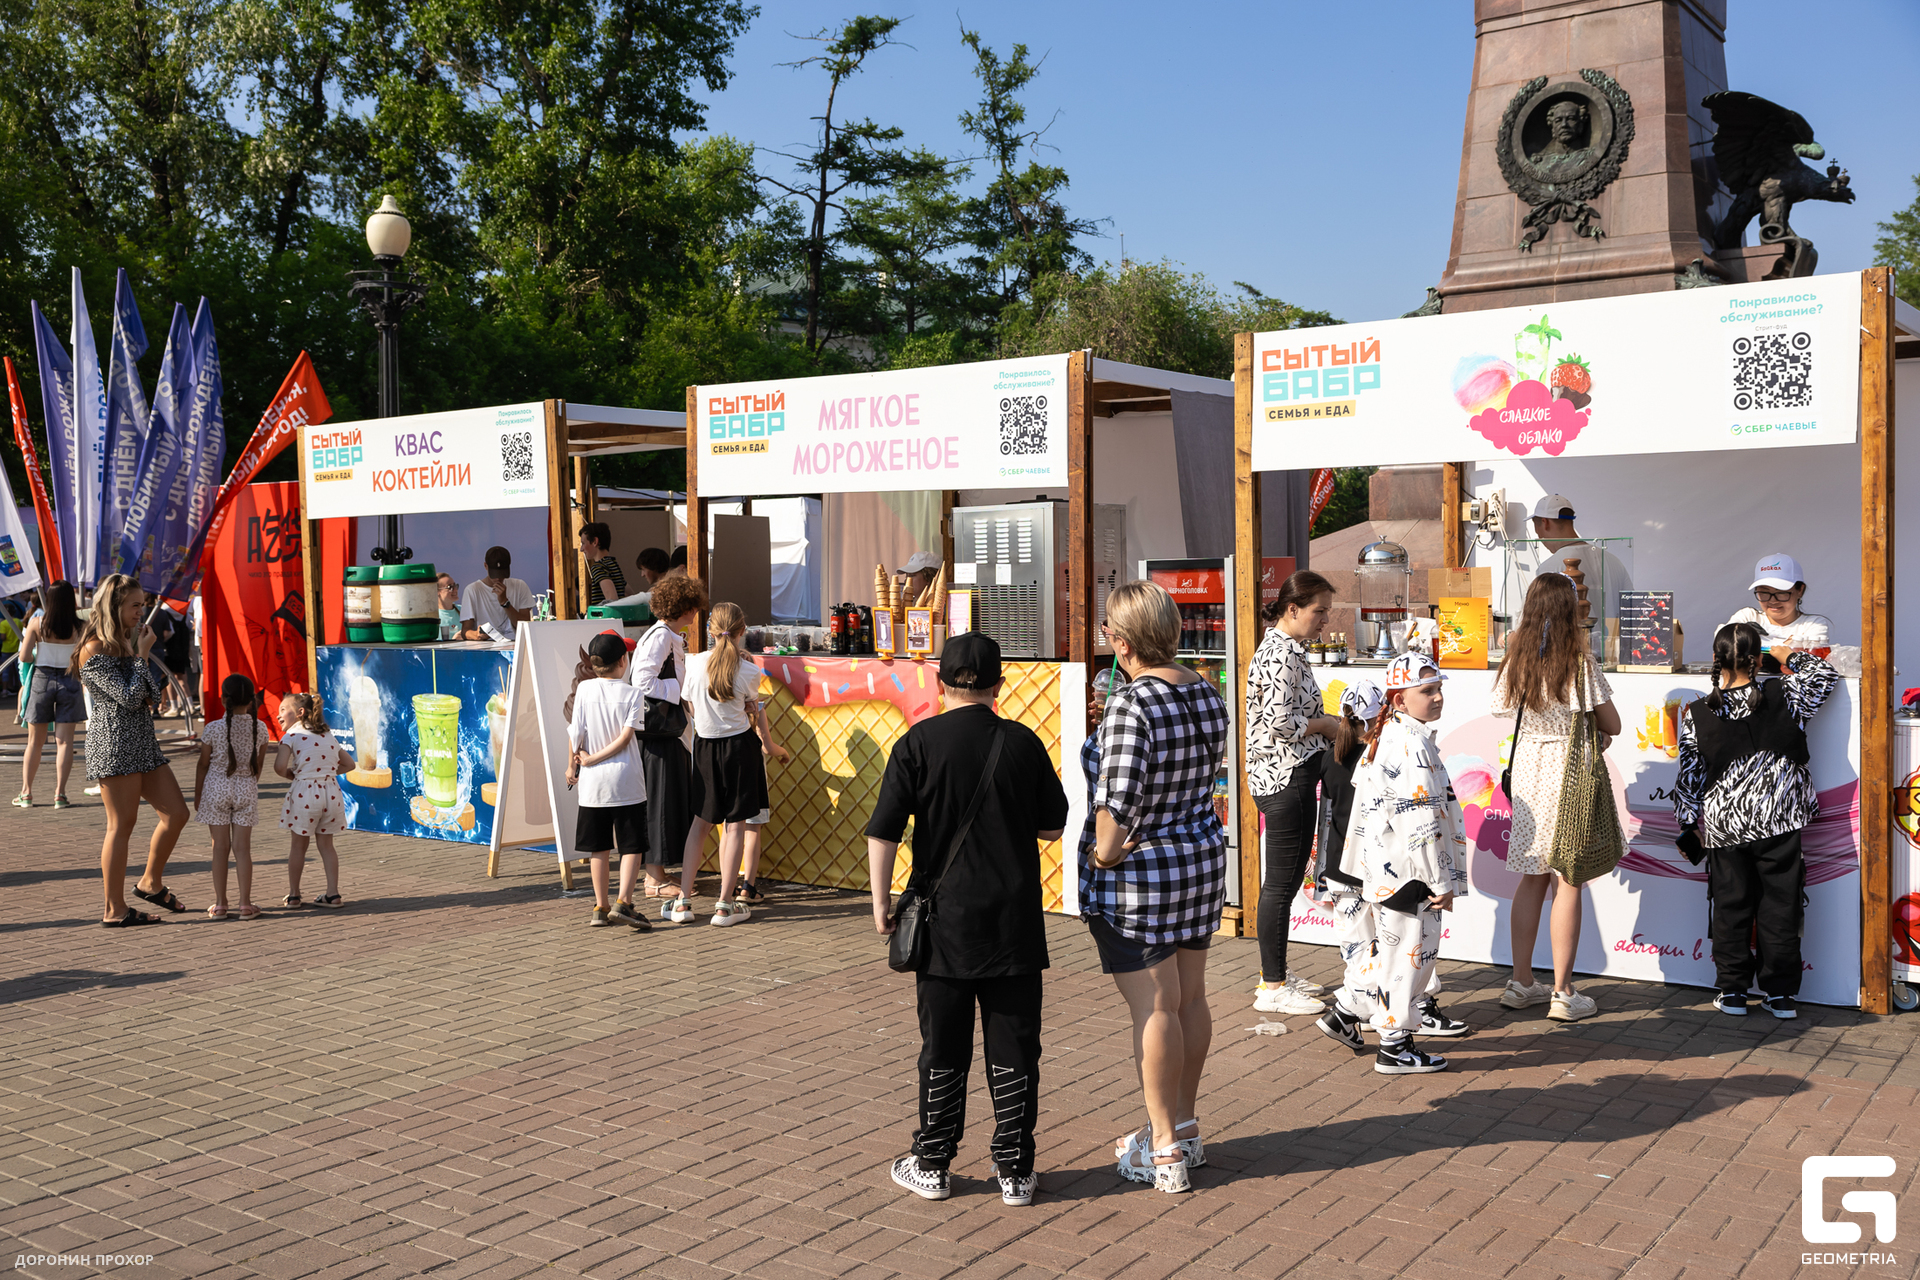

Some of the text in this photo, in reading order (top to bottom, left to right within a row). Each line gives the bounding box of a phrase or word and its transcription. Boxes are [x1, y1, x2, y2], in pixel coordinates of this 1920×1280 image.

[1729, 292, 1817, 309] Понравилось
[1720, 303, 1824, 324] обслуживание?
[1262, 336, 1381, 372] СЫТЫЙ
[993, 377, 1056, 391] обслуживание?
[998, 368, 1052, 380] Понравилось
[1263, 364, 1381, 402] БАБР
[709, 389, 785, 415] СЫТЫЙ
[818, 393, 920, 432] МЯГКОЕ
[1268, 404, 1351, 420] СЕМЬЯ и ЕДА
[709, 411, 786, 440] БАБР
[1499, 406, 1552, 425] СЛАДКОЕ
[1517, 428, 1564, 446] ОБЛАКО
[1745, 421, 1817, 434] СБЕР ЧАЕВЫЕ
[312, 428, 363, 450] СЫТЫЙ
[395, 430, 443, 457] КВАС
[713, 444, 740, 454] СЕМЬЯ
[749, 442, 766, 453] ЕДА
[114, 431, 138, 493] ДНЁМ
[312, 446, 363, 469] БАБР
[792, 436, 960, 476] МОРОЖЕНОЕ
[186, 422, 225, 531] ЛЮБИМЫЙ
[315, 472, 334, 482] СЕМЬЯ
[340, 471, 351, 480] ЕДА
[372, 460, 472, 493] КОКТЕЙЛИ
[1006, 466, 1051, 476] СБЕР ЧАЕВЫЕ
[123, 430, 178, 542] ЛЮБИМЫЙ
[1168, 586, 1208, 594] ЧЕРНОГОЛОВКА
[1614, 933, 1703, 961] яблоки в
